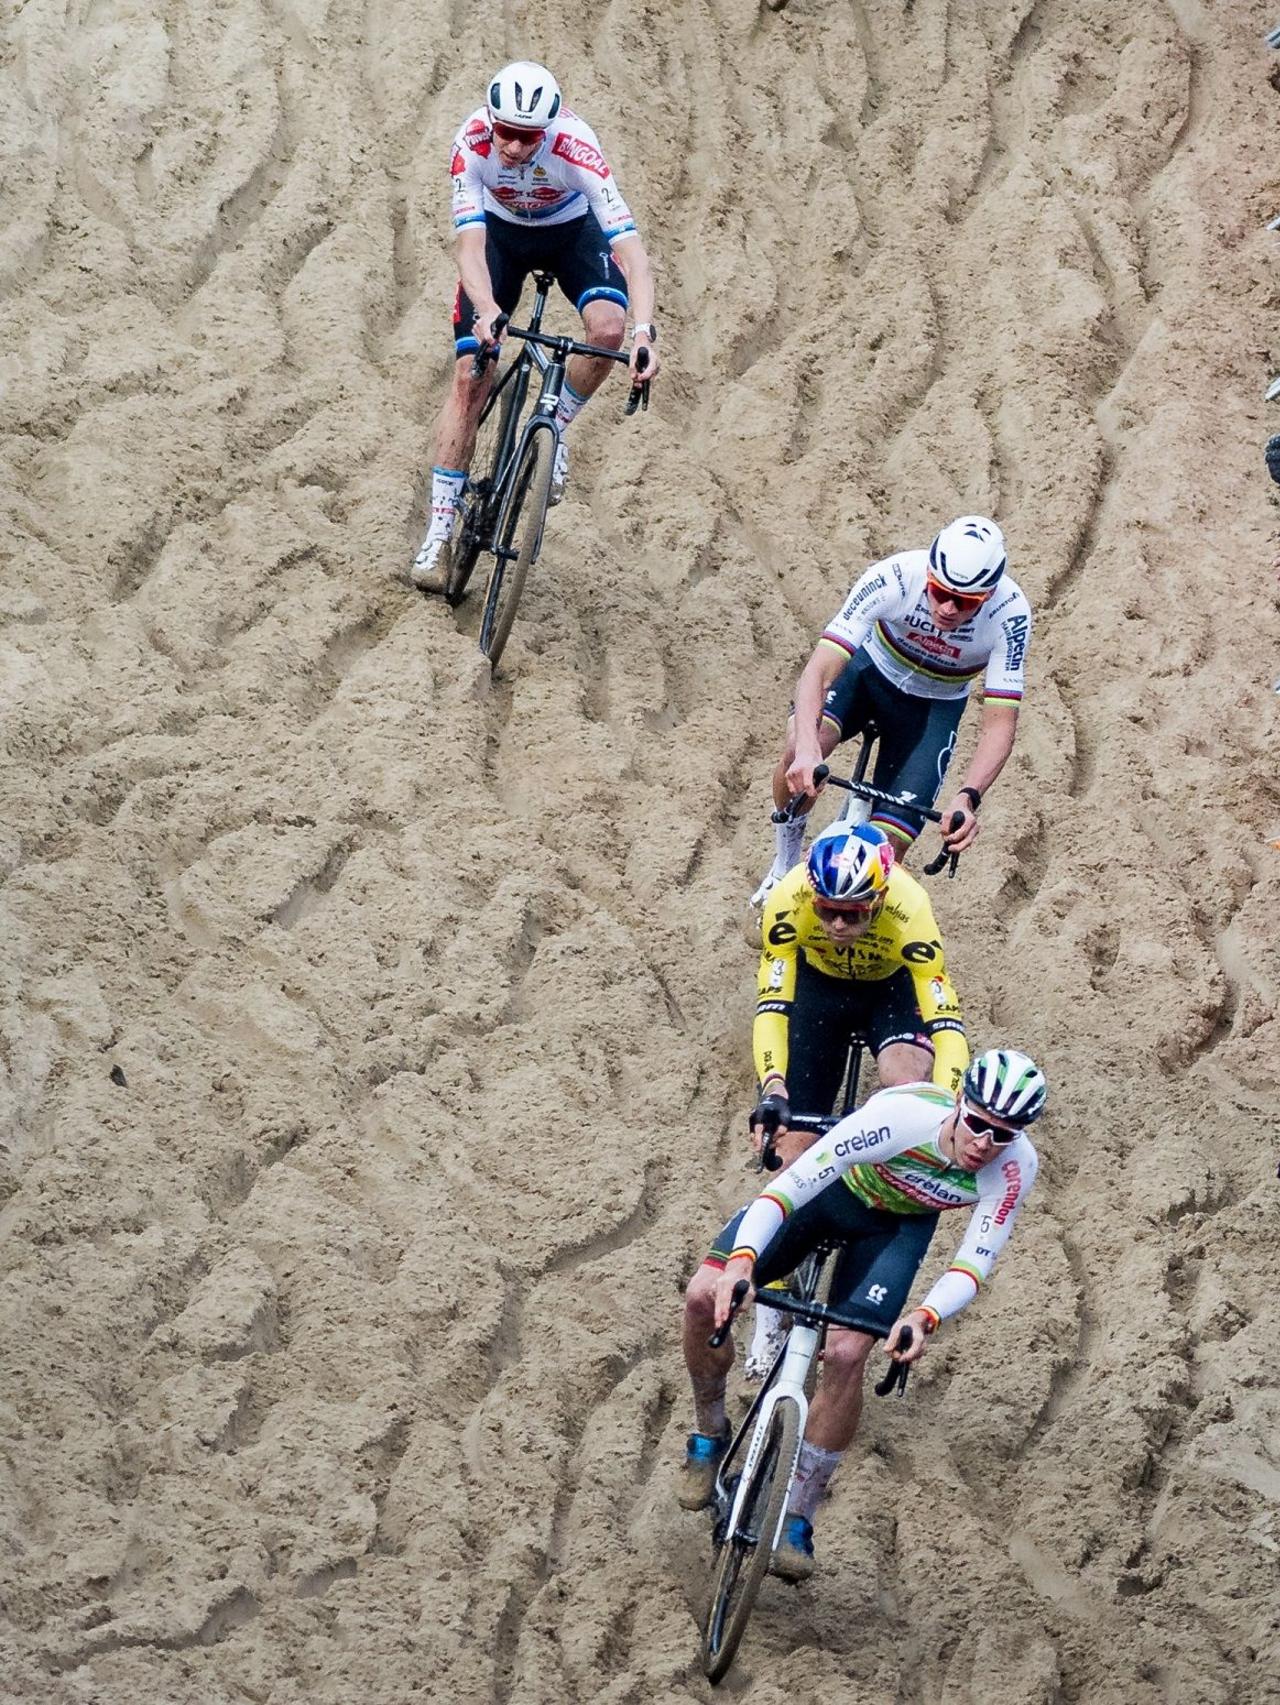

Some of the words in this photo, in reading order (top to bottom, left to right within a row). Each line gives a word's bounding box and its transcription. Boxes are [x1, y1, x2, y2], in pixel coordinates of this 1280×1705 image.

[558, 135, 608, 175] BINGOAL
[455, 178, 465, 192] 2
[601, 187, 614, 203] 2
[842, 573, 888, 621] deceuninck
[914, 634, 955, 657] Alpecin
[1007, 614, 1028, 671] Alpecin
[834, 1125, 892, 1157] crelan
[818, 1166, 836, 1179] 5
[904, 1173, 962, 1203] crelan
[994, 1160, 1021, 1226] corendon
[980, 1215, 992, 1233] 5
[976, 1246, 991, 1257] DT
